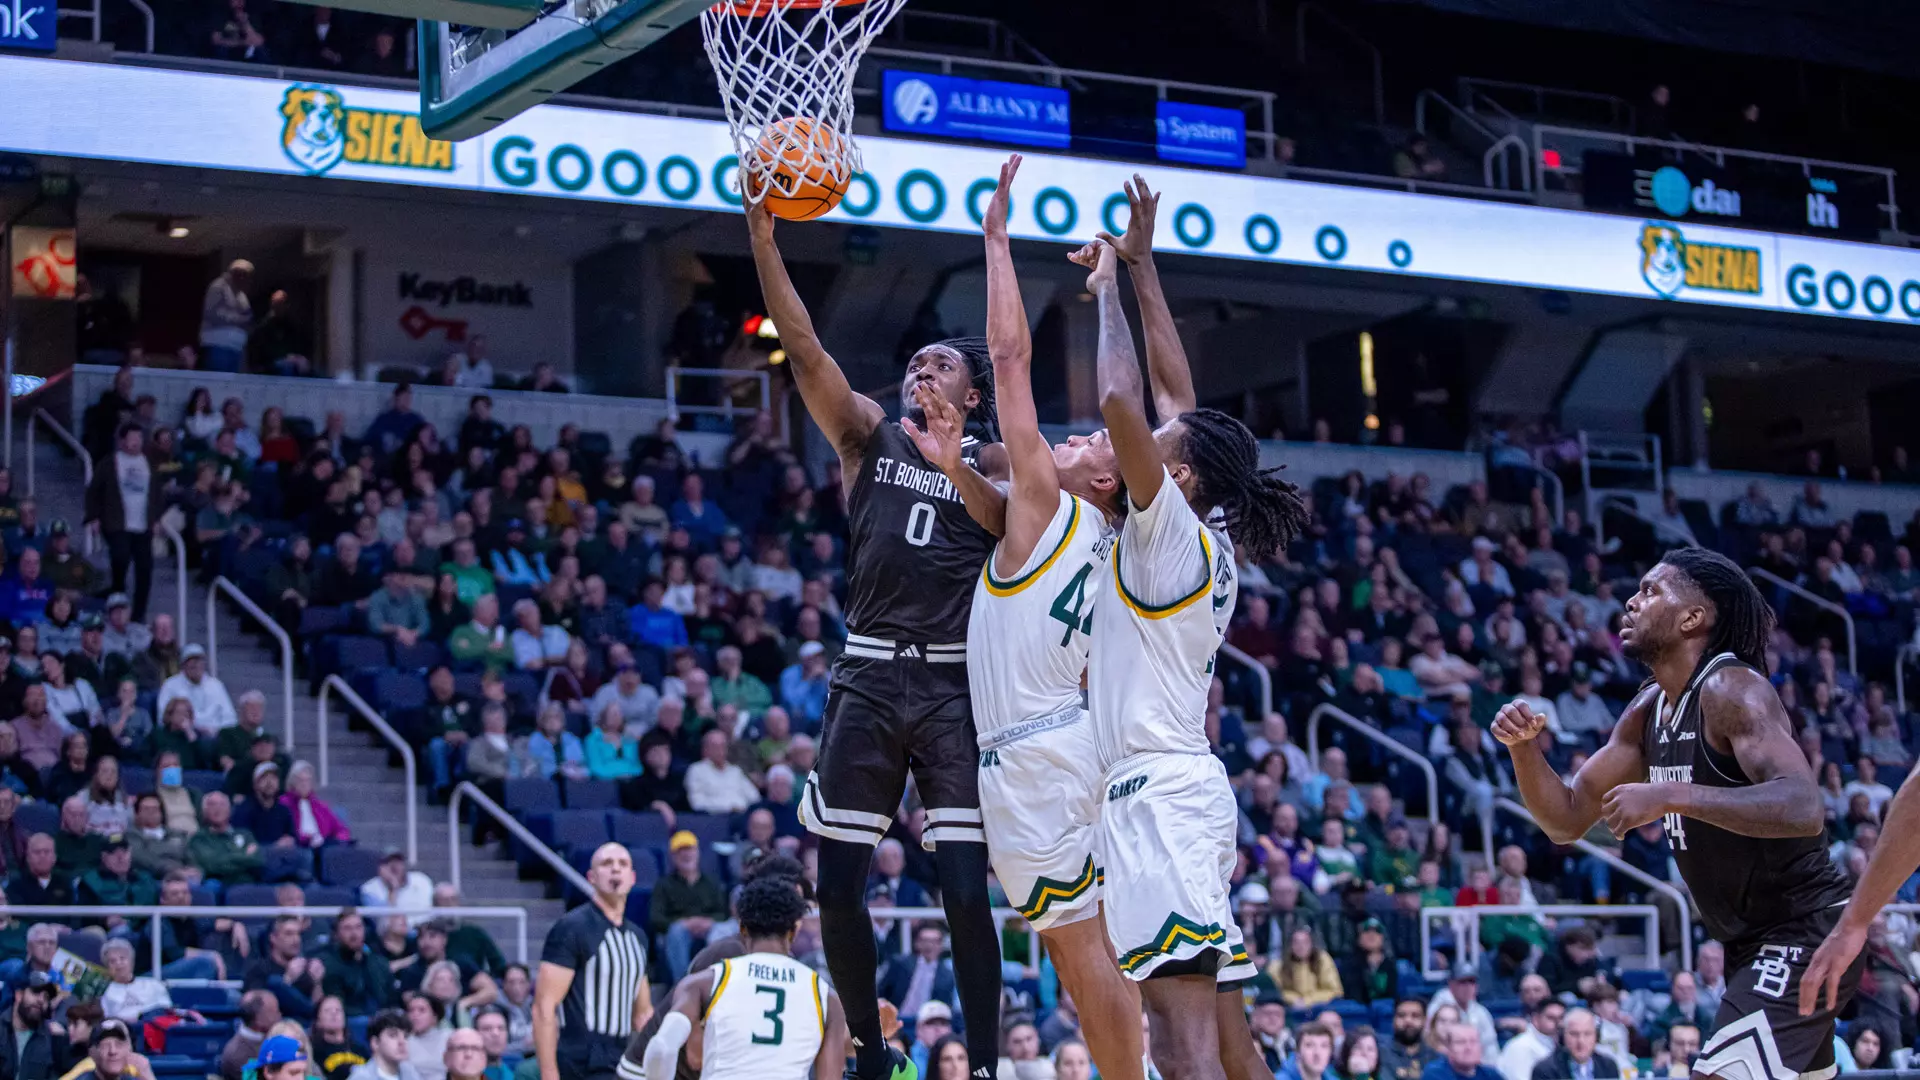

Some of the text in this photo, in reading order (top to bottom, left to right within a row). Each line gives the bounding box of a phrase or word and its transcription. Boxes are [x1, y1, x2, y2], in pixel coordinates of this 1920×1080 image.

[946, 91, 1039, 121] ALBANY
[344, 110, 452, 169] SIENA
[1170, 116, 1237, 144] System
[1685, 244, 1760, 293] SIENA
[399, 271, 533, 307] KeyBank
[875, 457, 894, 483] ST.
[905, 501, 936, 547] 0
[992, 716, 1054, 742] ARMOUR
[748, 962, 796, 983] FREEMAN
[751, 984, 786, 1046] 3
